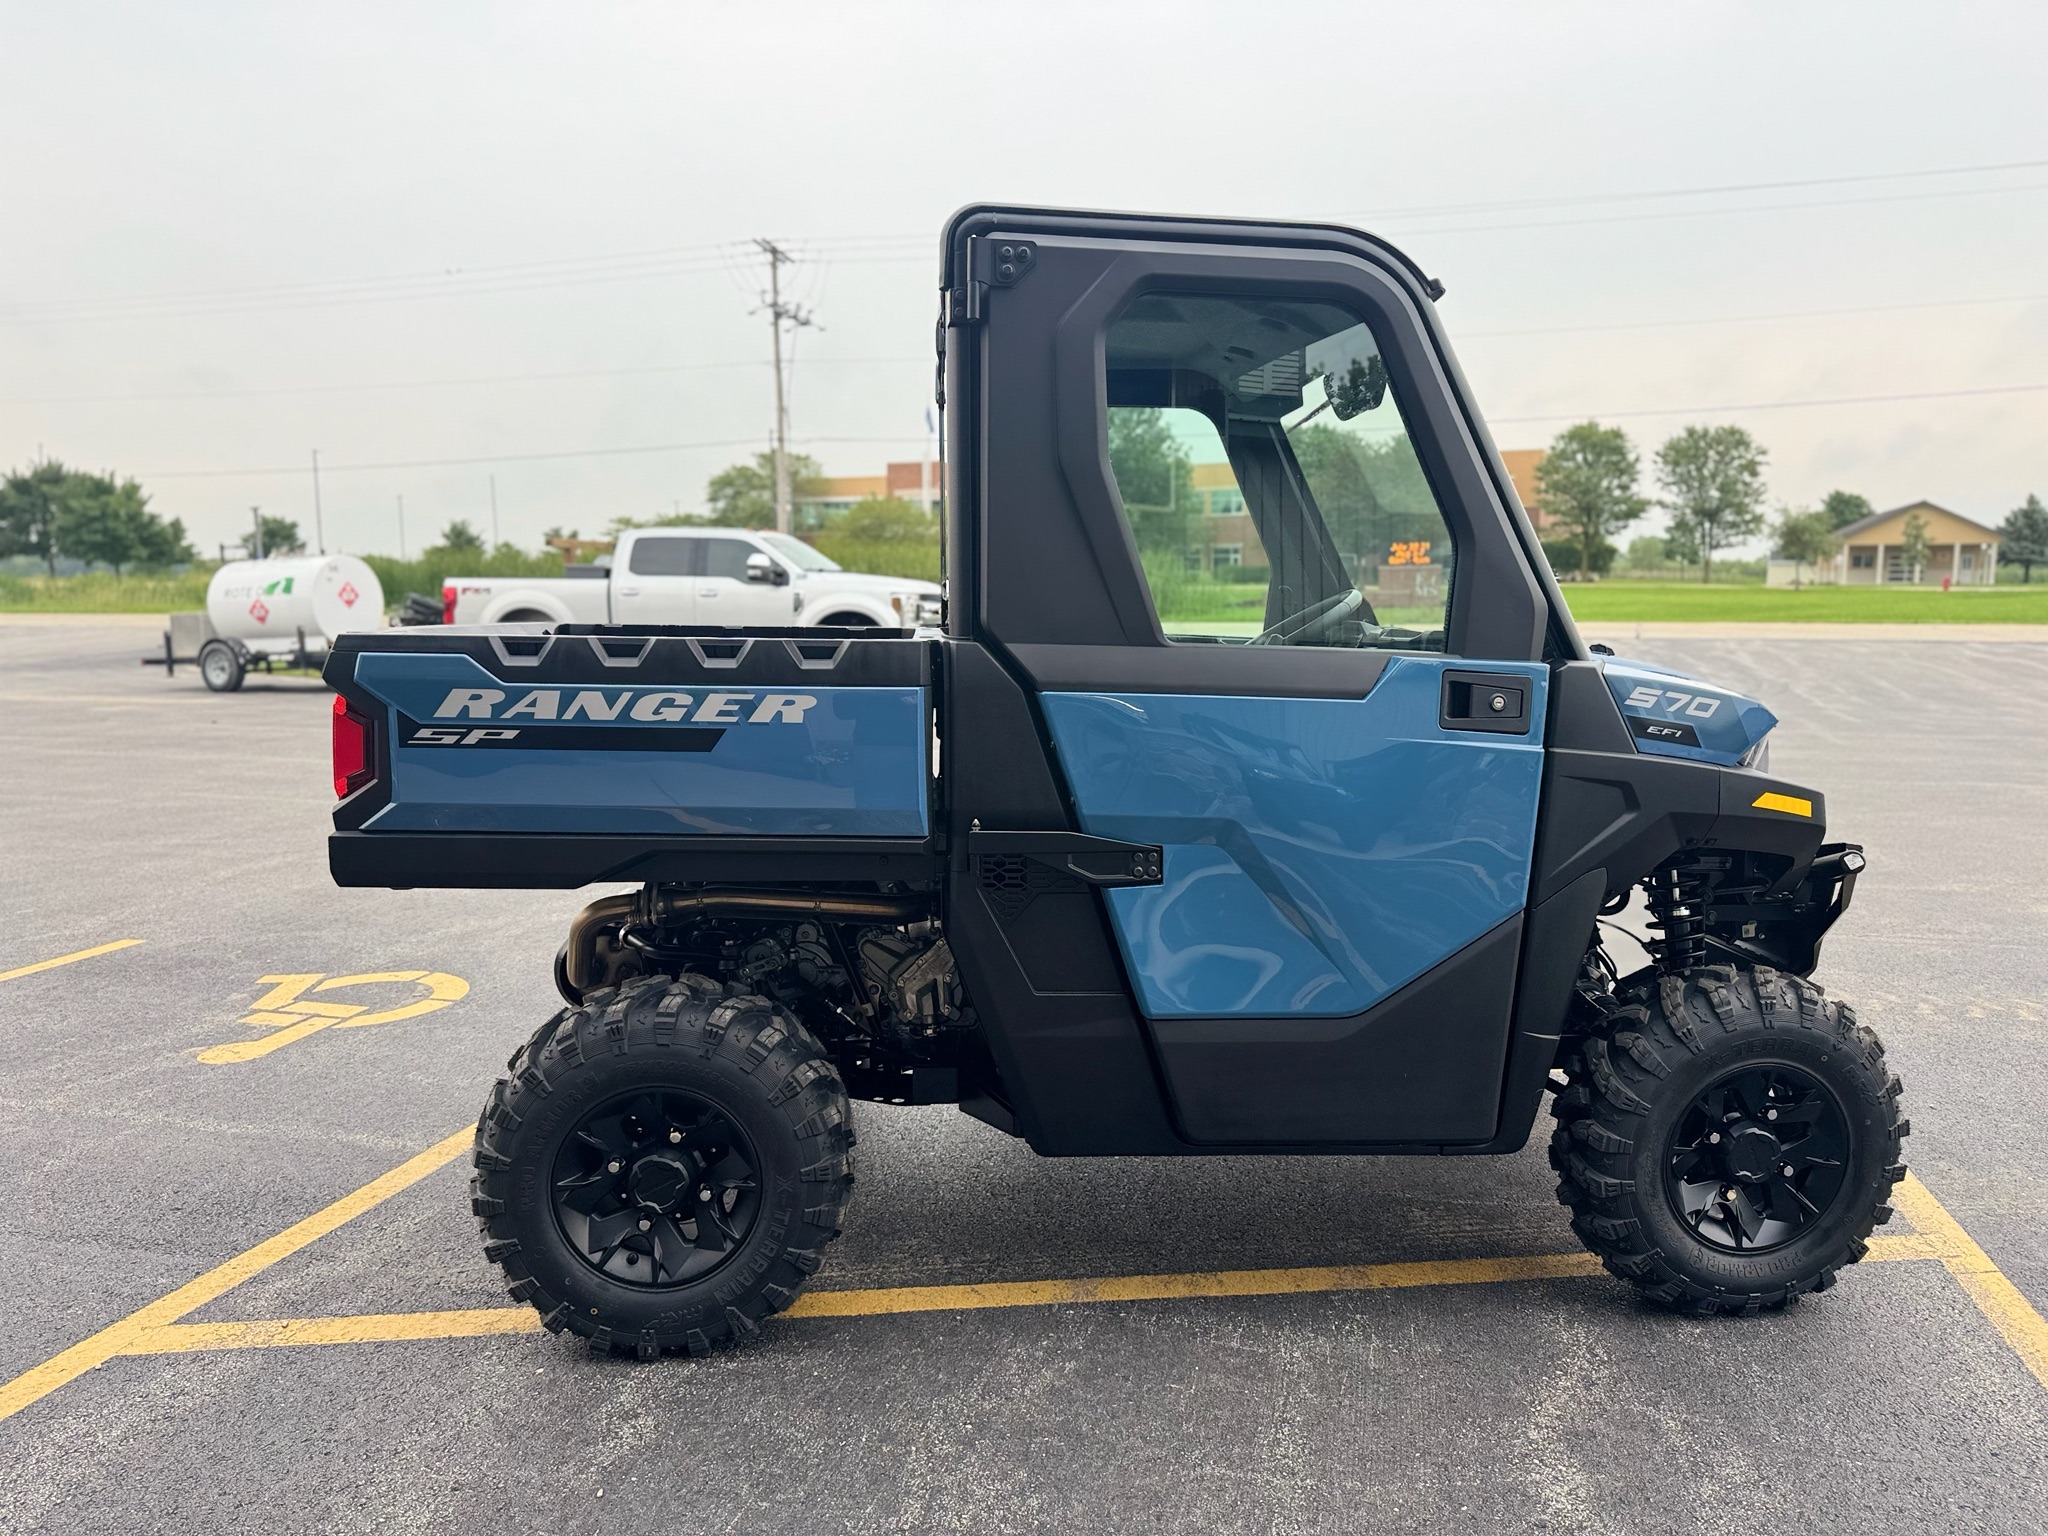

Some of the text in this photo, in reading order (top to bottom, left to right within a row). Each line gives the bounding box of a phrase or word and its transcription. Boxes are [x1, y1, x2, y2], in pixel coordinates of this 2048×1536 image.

[432, 688, 818, 724] RANGER
[1623, 686, 1721, 718] 570
[406, 728, 522, 745] SP
[1646, 725, 1683, 738] EFI
[713, 1175, 794, 1305] X-TERRAIN
